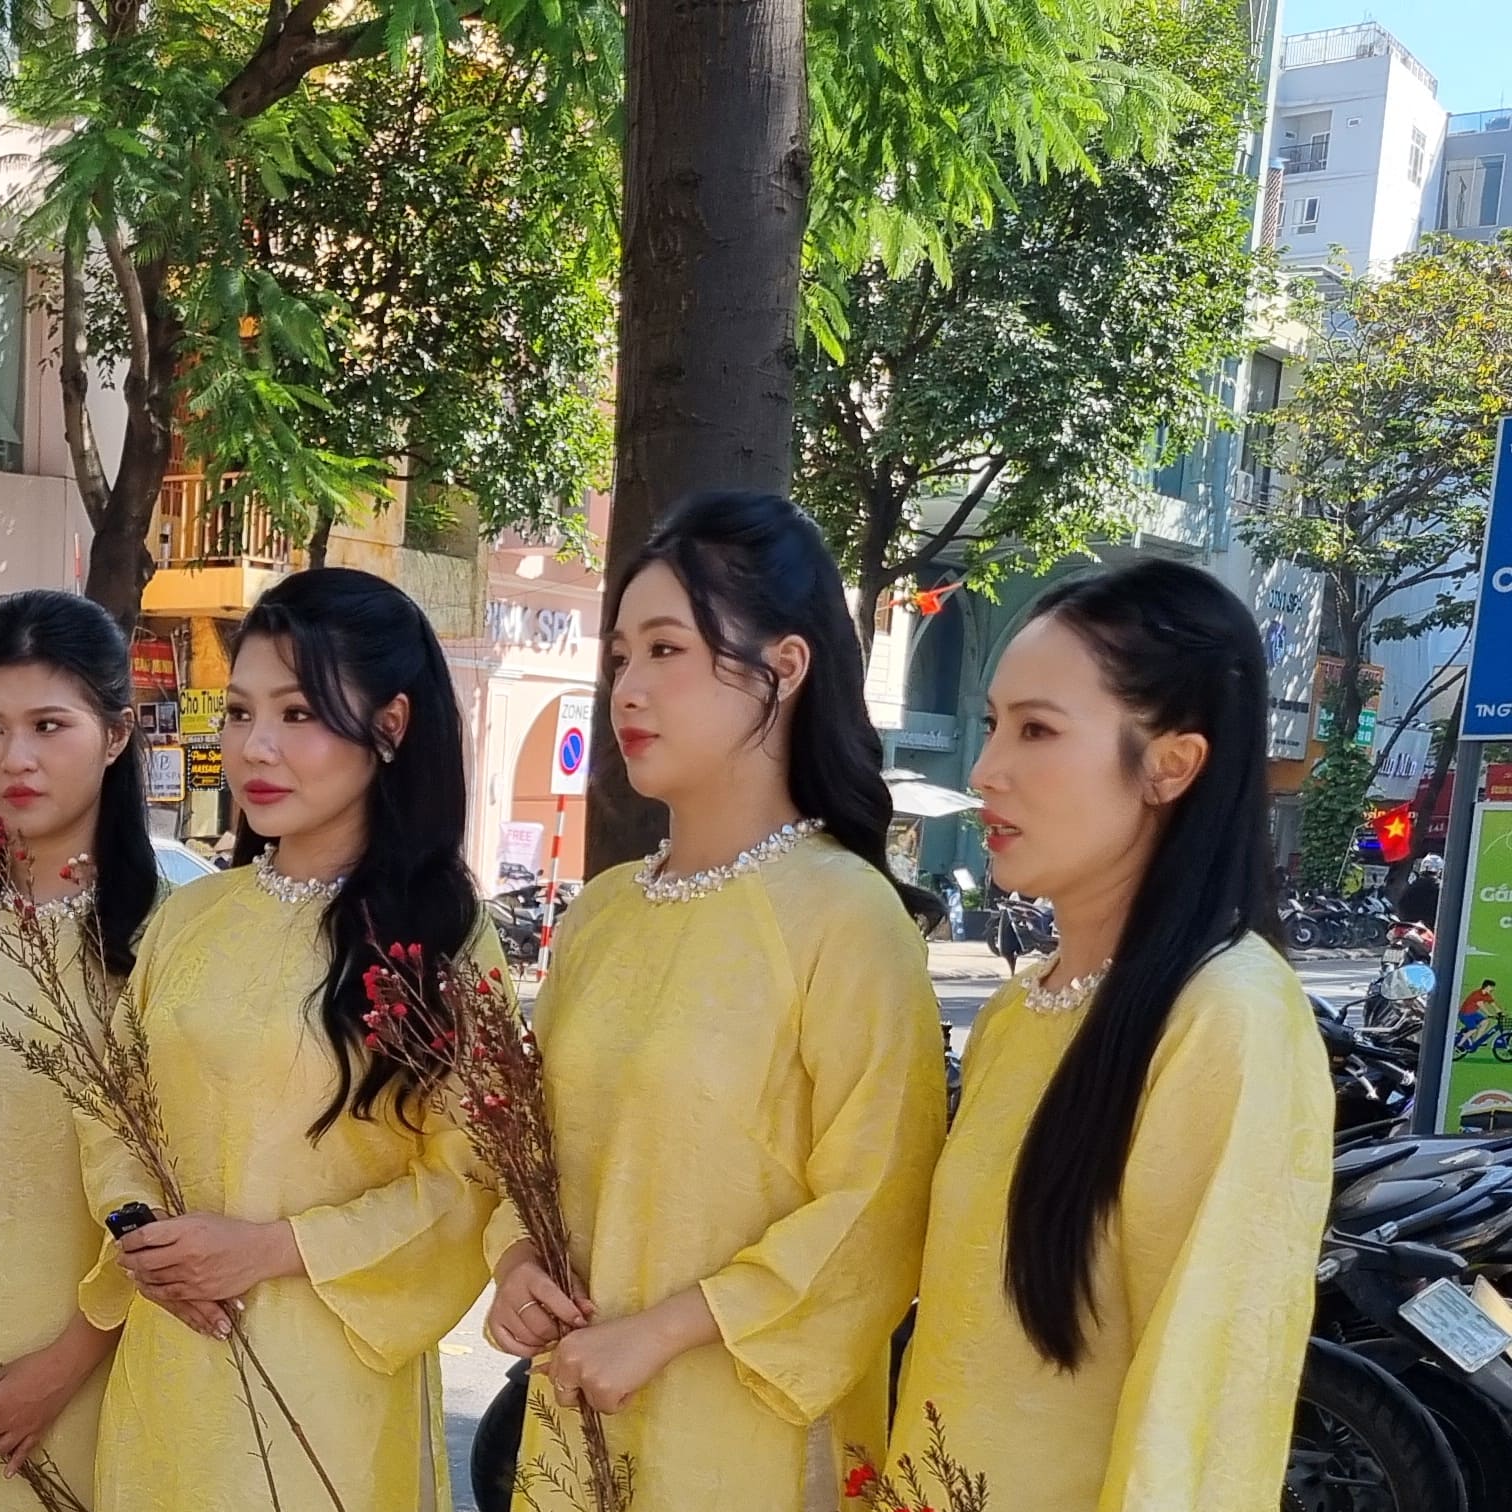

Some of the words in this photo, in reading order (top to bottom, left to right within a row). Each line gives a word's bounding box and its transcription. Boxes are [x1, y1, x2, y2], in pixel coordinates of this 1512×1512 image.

[537, 608, 583, 650] SPA
[180, 691, 198, 714] Cho
[561, 703, 590, 720] ZONE
[507, 829, 533, 842] FREE
